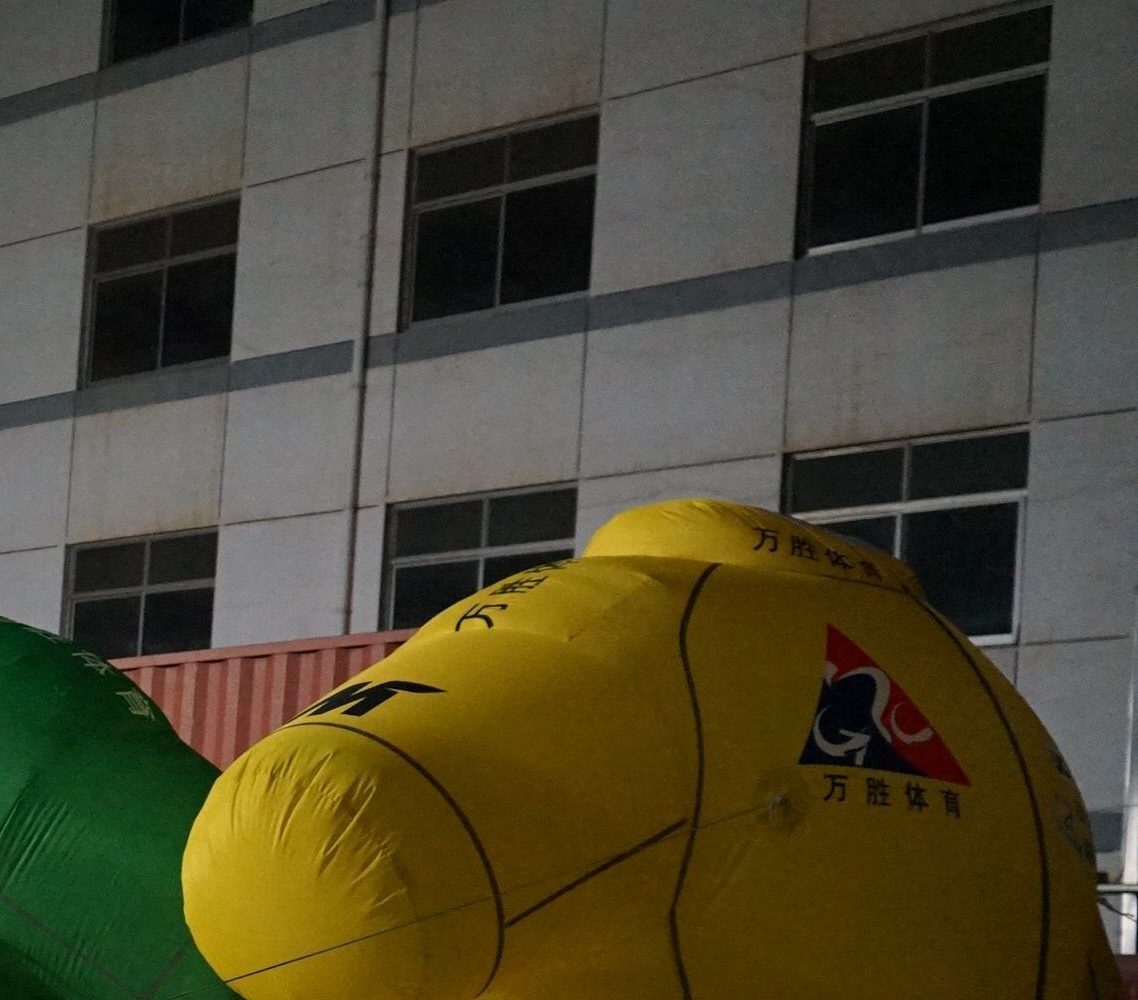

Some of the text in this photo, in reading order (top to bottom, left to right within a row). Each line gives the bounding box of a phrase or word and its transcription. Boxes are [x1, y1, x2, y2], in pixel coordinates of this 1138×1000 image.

[752, 526, 884, 581] 万胜体育
[823, 773, 961, 819] 万胜体育
